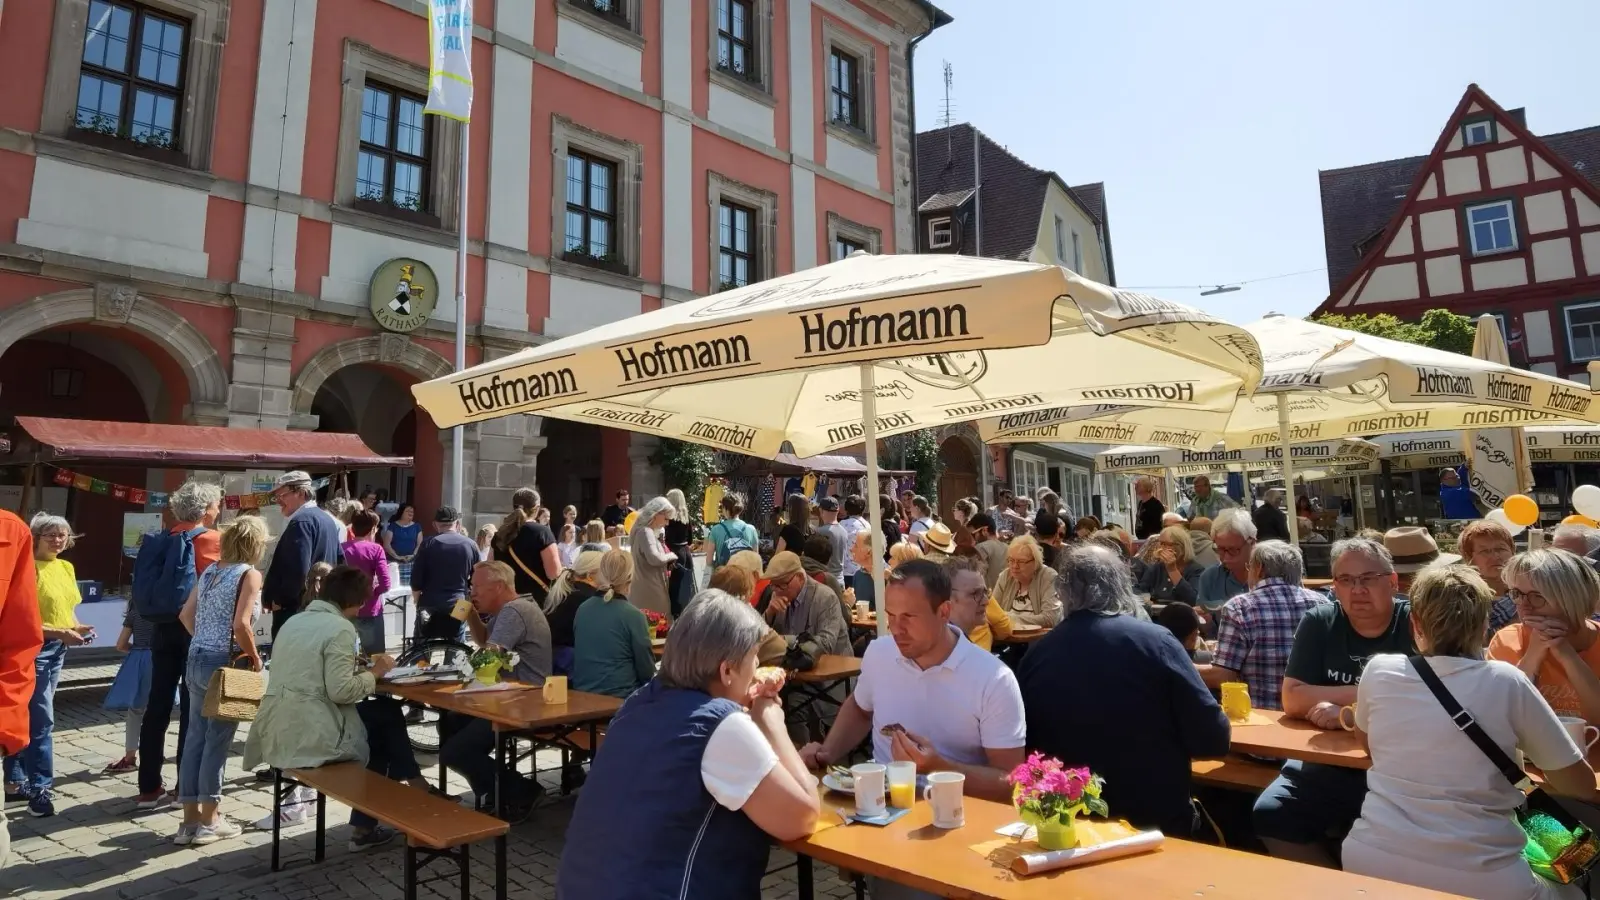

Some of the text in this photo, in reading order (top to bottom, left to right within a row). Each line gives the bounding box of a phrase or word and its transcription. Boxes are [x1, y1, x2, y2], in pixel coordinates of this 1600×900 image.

[376, 307, 426, 330] RATHAUS
[799, 304, 970, 353] Hofmann
[615, 335, 751, 381] Hofmann
[458, 367, 578, 413] Hofmann
[1417, 367, 1474, 395] Hofmann
[1487, 373, 1532, 402] Hofmann
[1547, 385, 1591, 413] Hofmann
[1265, 445, 1330, 459] Homann
[1392, 440, 1451, 453] Hofmann
[1104, 454, 1161, 469] Hofmann
[89, 586, 97, 596] R
